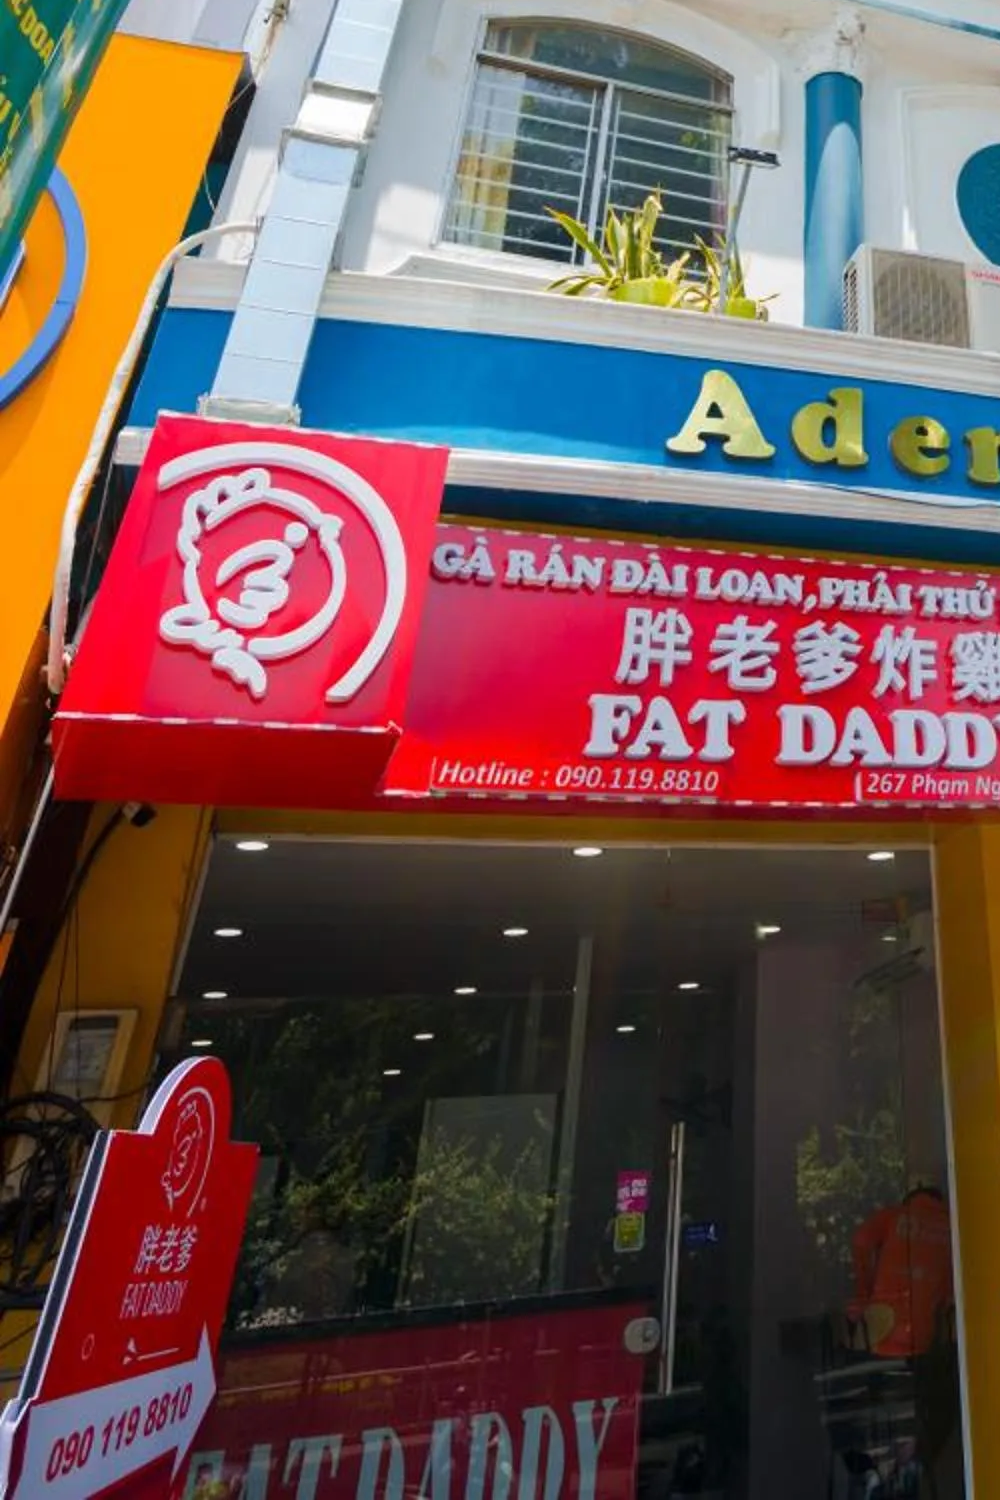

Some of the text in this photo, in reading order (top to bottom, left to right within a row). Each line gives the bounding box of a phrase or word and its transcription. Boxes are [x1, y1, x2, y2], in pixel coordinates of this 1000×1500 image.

[432, 536, 495, 583] GÀ
[504, 543, 606, 590] RÁN
[609, 553, 690, 595] ĐÀI
[917, 579, 997, 619] THỦ
[582, 693, 747, 762] FAT
[438, 760, 534, 786] Hotline
[554, 764, 720, 793] 090.119.8810
[867, 773, 905, 794] 267
[911, 774, 969, 799] Phạm
[45, 1381, 194, 1483] 090 119 8810
